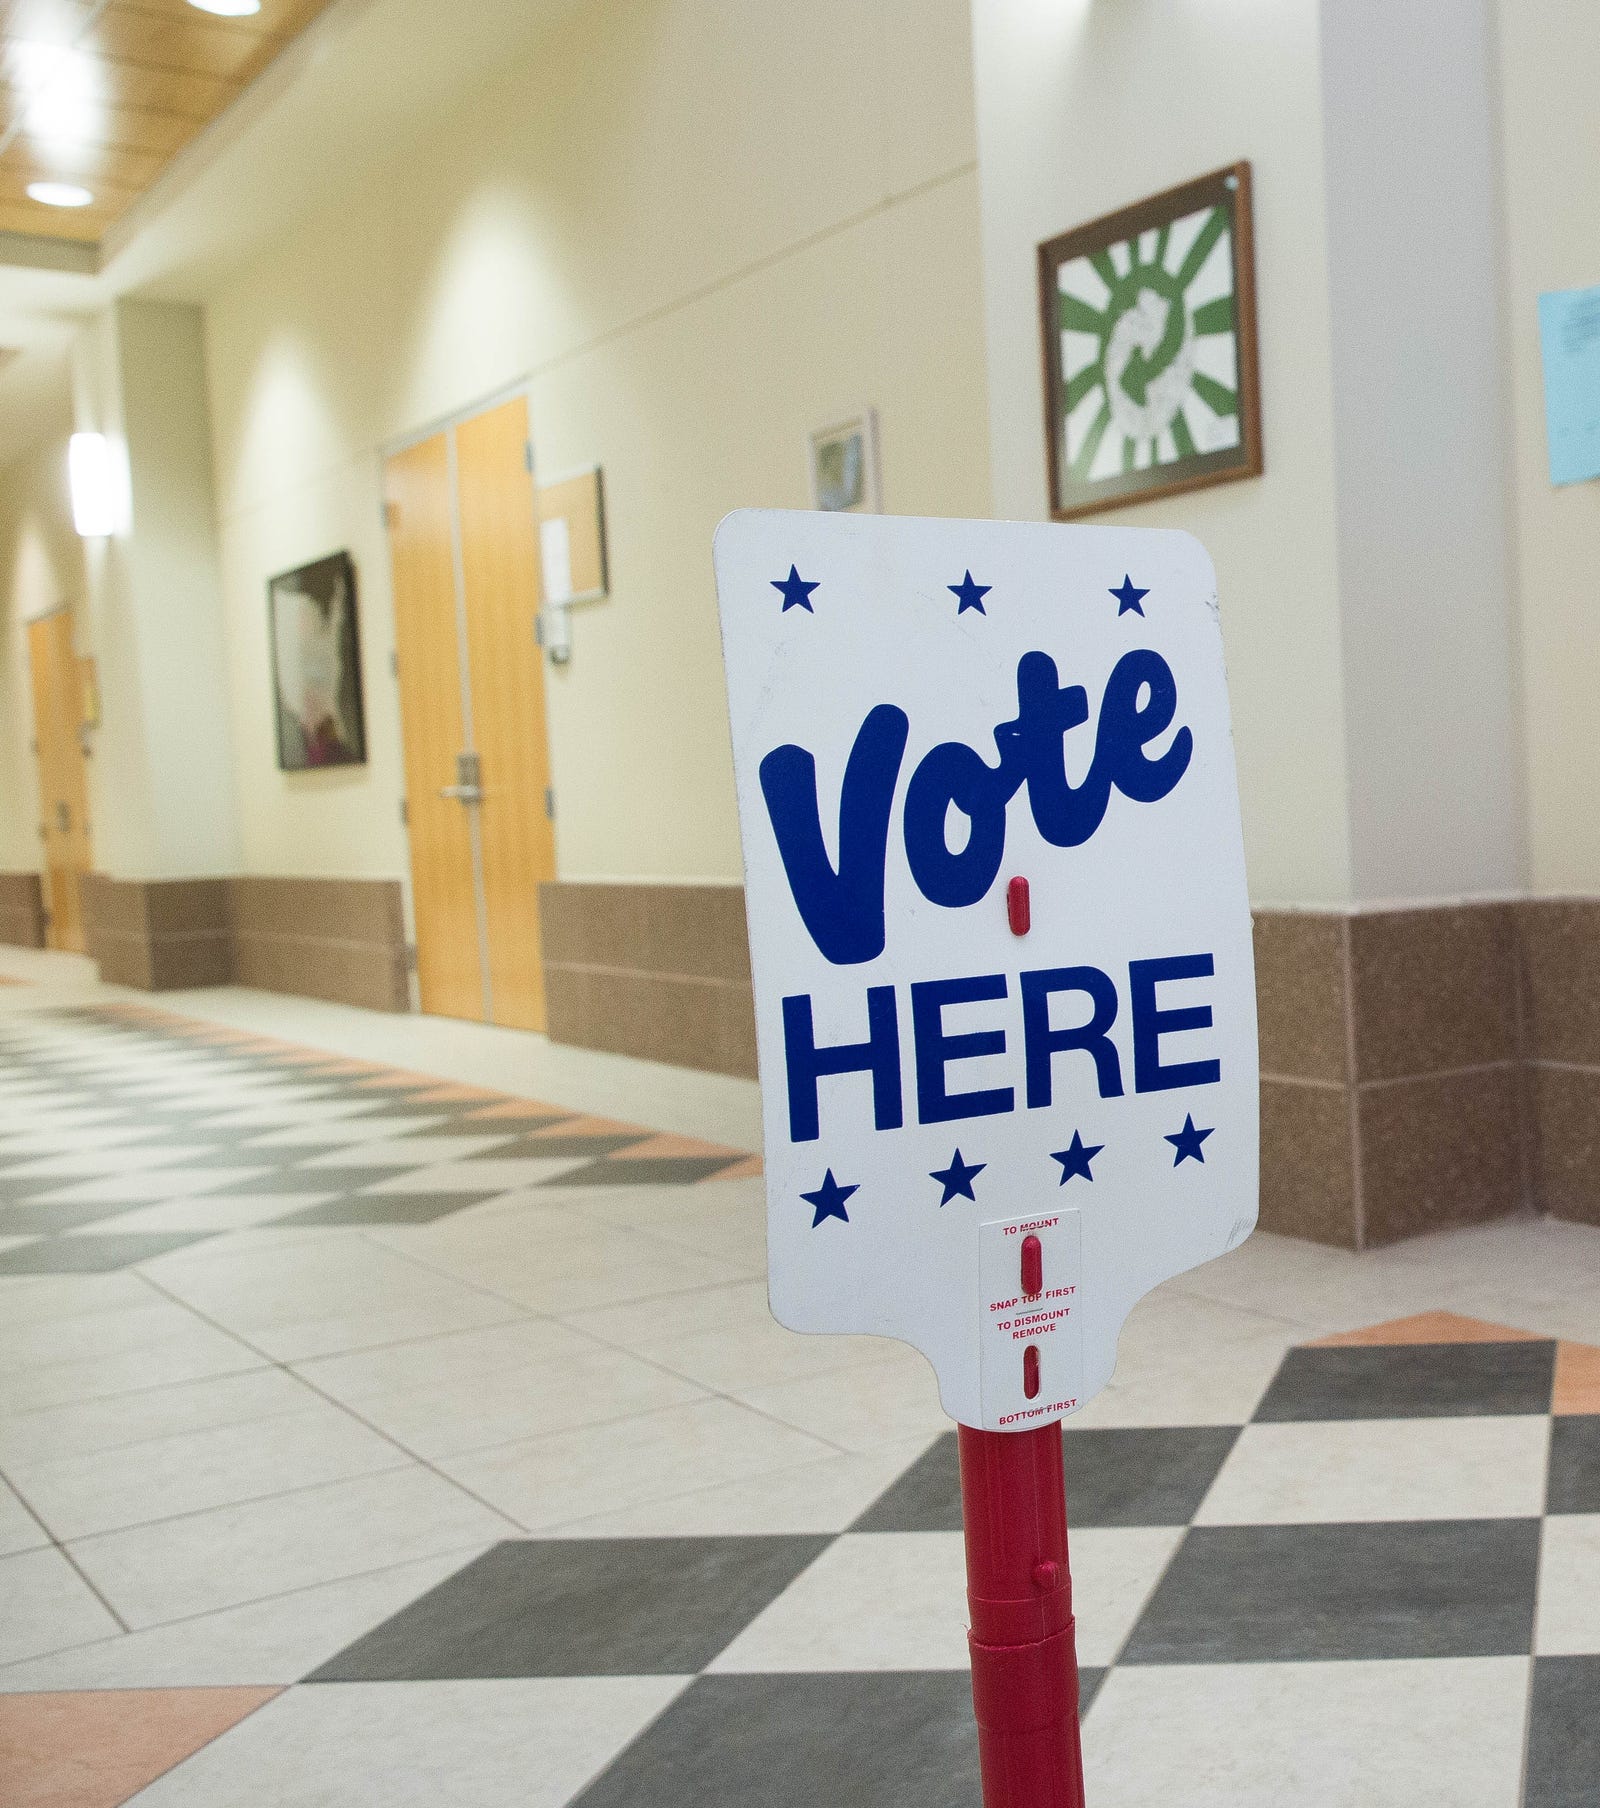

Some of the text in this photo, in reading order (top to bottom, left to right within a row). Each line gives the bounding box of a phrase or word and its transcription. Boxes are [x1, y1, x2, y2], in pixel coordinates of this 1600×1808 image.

[759, 649, 1193, 965] Vote
[782, 953, 1221, 1143] HERE
[1003, 1218, 1059, 1236] TO MOUNT
[990, 1286, 1077, 1312] SNAP TOP FIRST
[997, 1308, 1070, 1331] TO DISMOUNT
[1012, 1323, 1056, 1340] REMOVE
[999, 1399, 1077, 1425] BOTTOM FIRST
